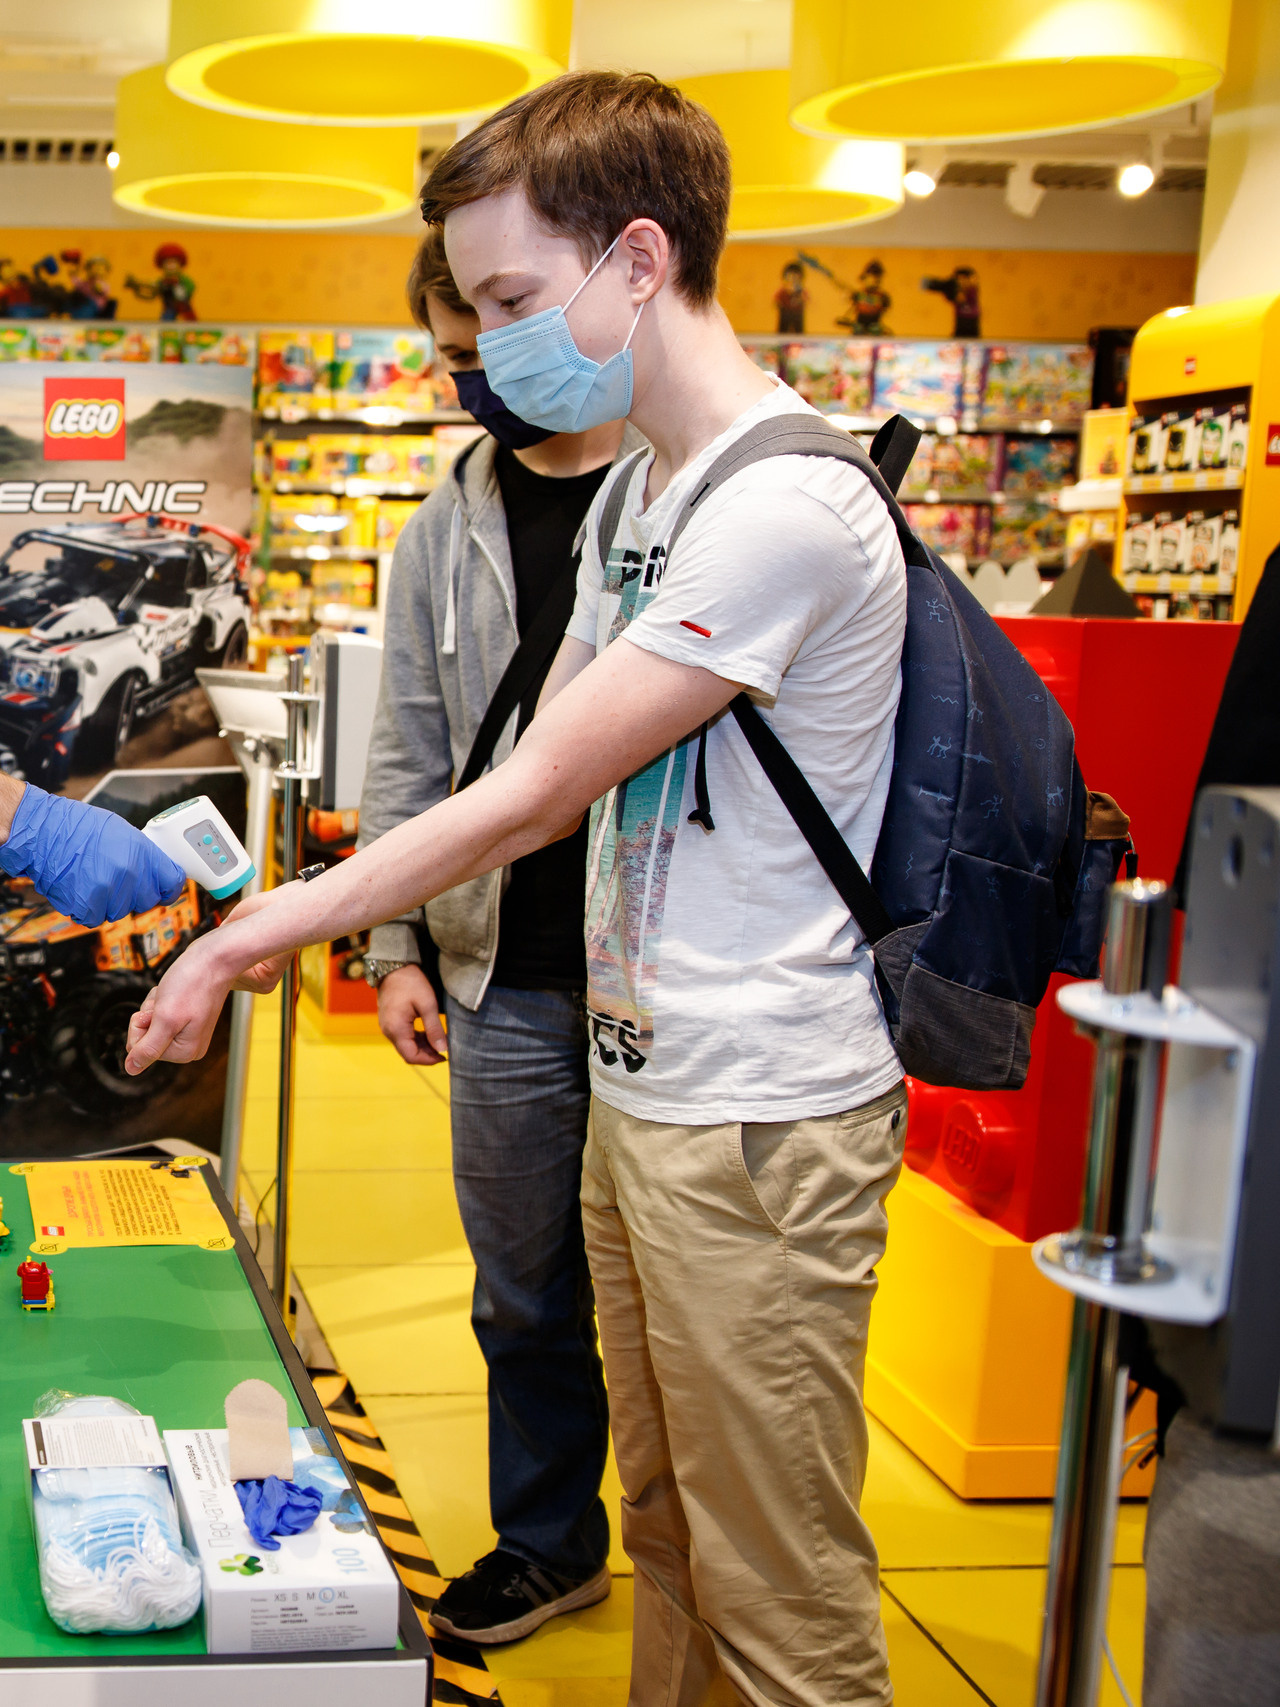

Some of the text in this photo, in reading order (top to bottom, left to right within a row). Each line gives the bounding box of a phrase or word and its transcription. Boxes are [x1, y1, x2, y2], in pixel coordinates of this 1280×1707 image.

[47, 399, 124, 438] LEGO
[200, 1490, 235, 1548] Перчатки
[332, 1548, 368, 1574] 100
[274, 1592, 287, 1602] XS
[291, 1592, 299, 1602] S
[306, 1592, 315, 1601] M
[337, 1590, 349, 1599] XL
